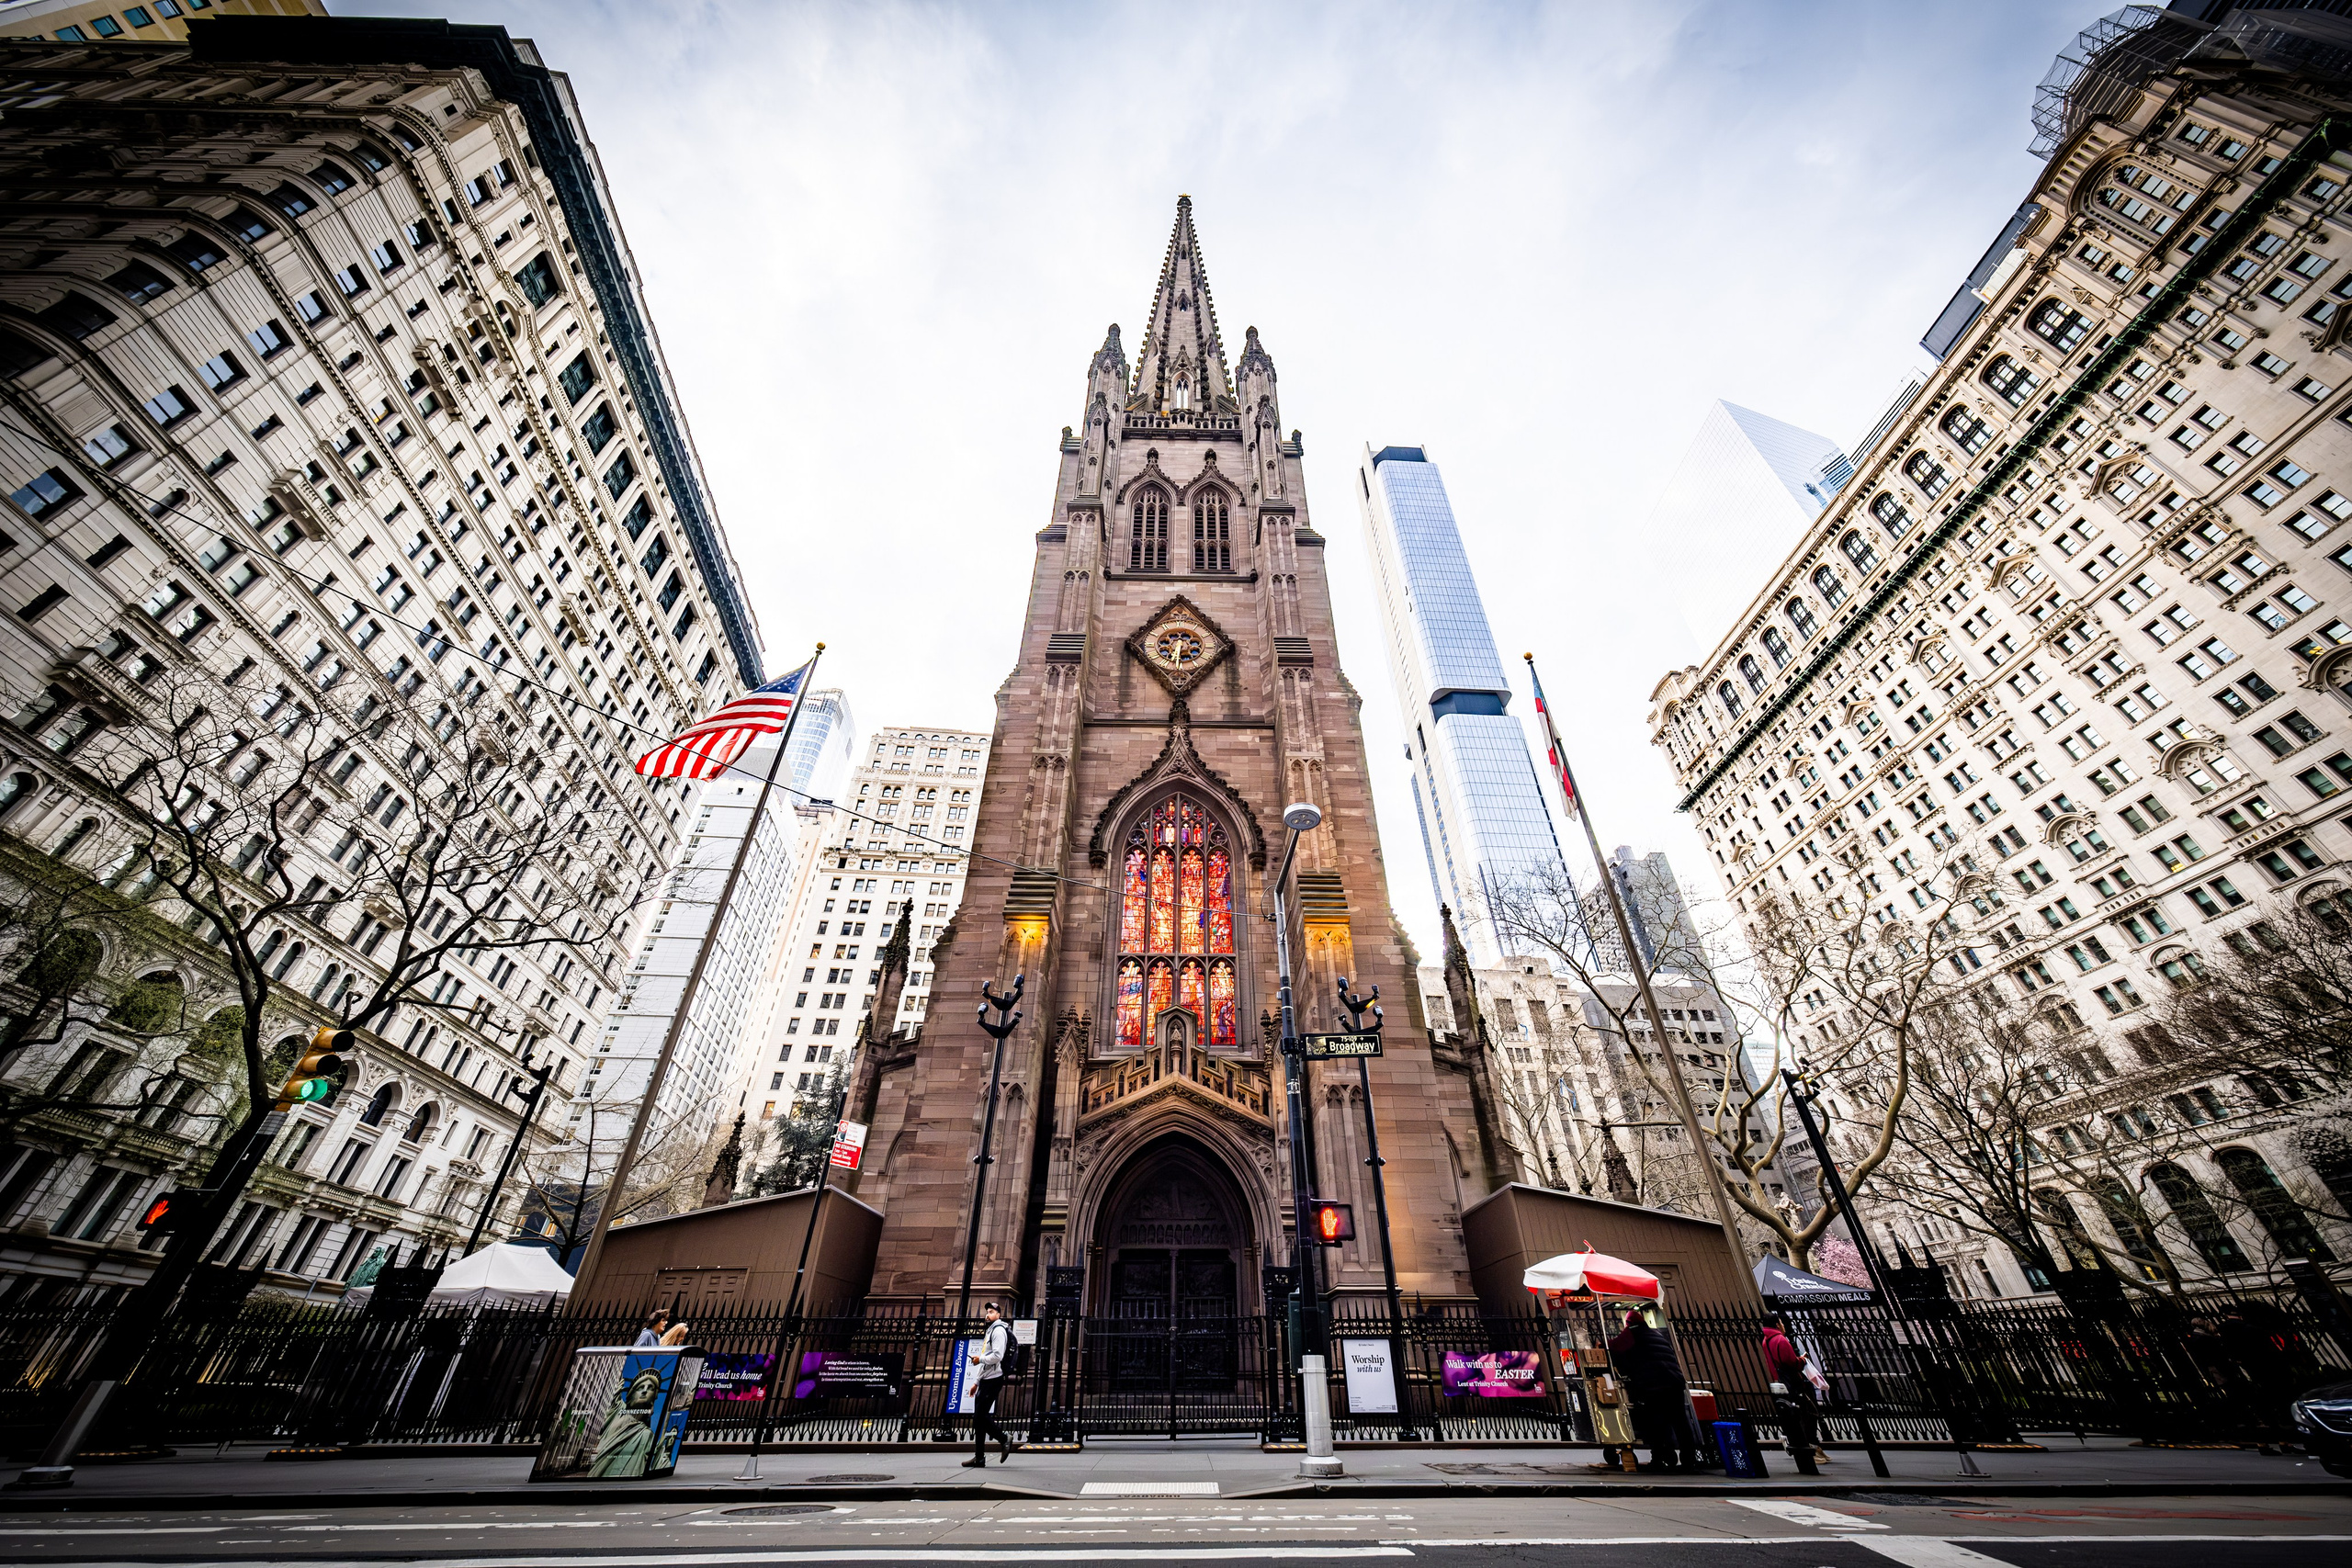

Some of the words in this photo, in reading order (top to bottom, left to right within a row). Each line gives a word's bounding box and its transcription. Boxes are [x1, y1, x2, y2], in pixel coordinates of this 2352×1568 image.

[1329, 1041, 1374, 1052] Broadway
[1778, 1293, 1838, 1304] COMPASSION
[1838, 1292, 1871, 1303] MEALS
[955, 1340, 966, 1367] Events
[1351, 1355, 1385, 1366] Worship
[1445, 1359, 1464, 1369] Walk
[1465, 1359, 1483, 1369] with
[713, 1370, 730, 1379] lead
[740, 1371, 763, 1380] home
[1494, 1370, 1534, 1379] EASTER
[948, 1368, 963, 1410] Upcoming
